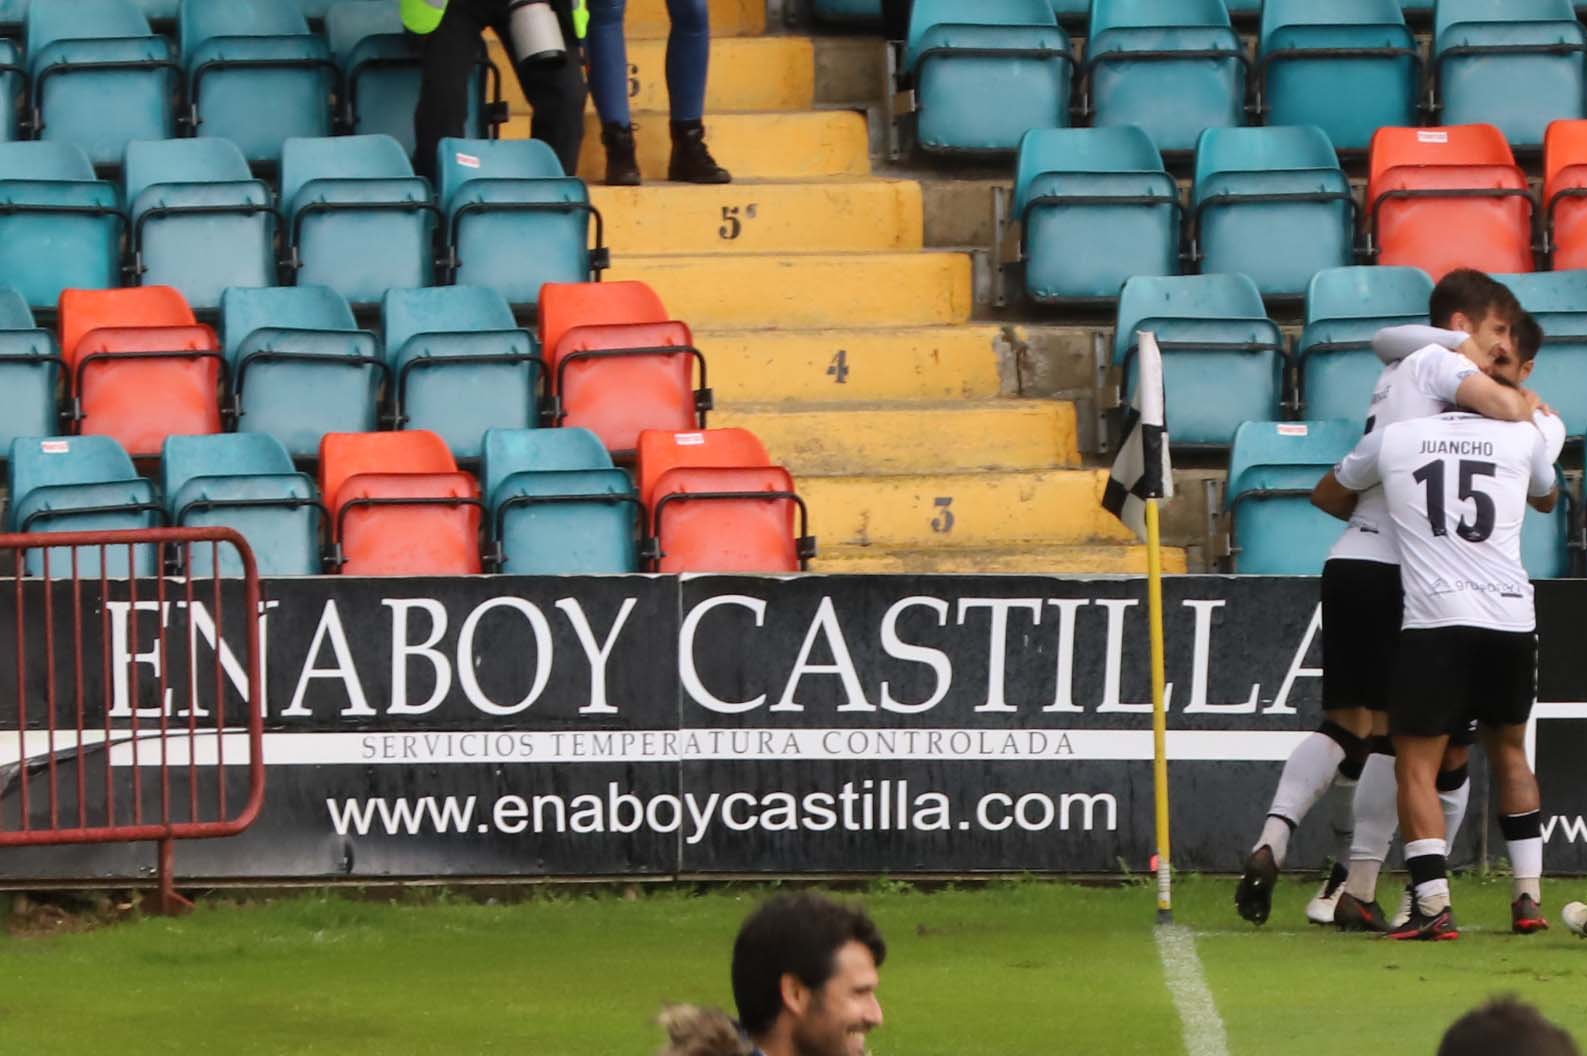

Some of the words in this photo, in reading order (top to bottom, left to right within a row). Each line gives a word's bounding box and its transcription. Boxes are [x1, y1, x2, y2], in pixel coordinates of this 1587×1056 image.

[719, 205, 741, 240] 5
[825, 350, 849, 384] 4
[1419, 439, 1493, 457] JUANCHO
[930, 496, 955, 533] 3
[1411, 458, 1497, 544] 15
[107, 596, 638, 719] ENABOY
[678, 594, 1324, 714] CASTILLA
[361, 732, 535, 760] SERVICIOS
[552, 730, 801, 758] TEMPERATURA
[822, 730, 1075, 756] CONTROLADA
[327, 779, 1117, 845] www.enaboycastilla.com
